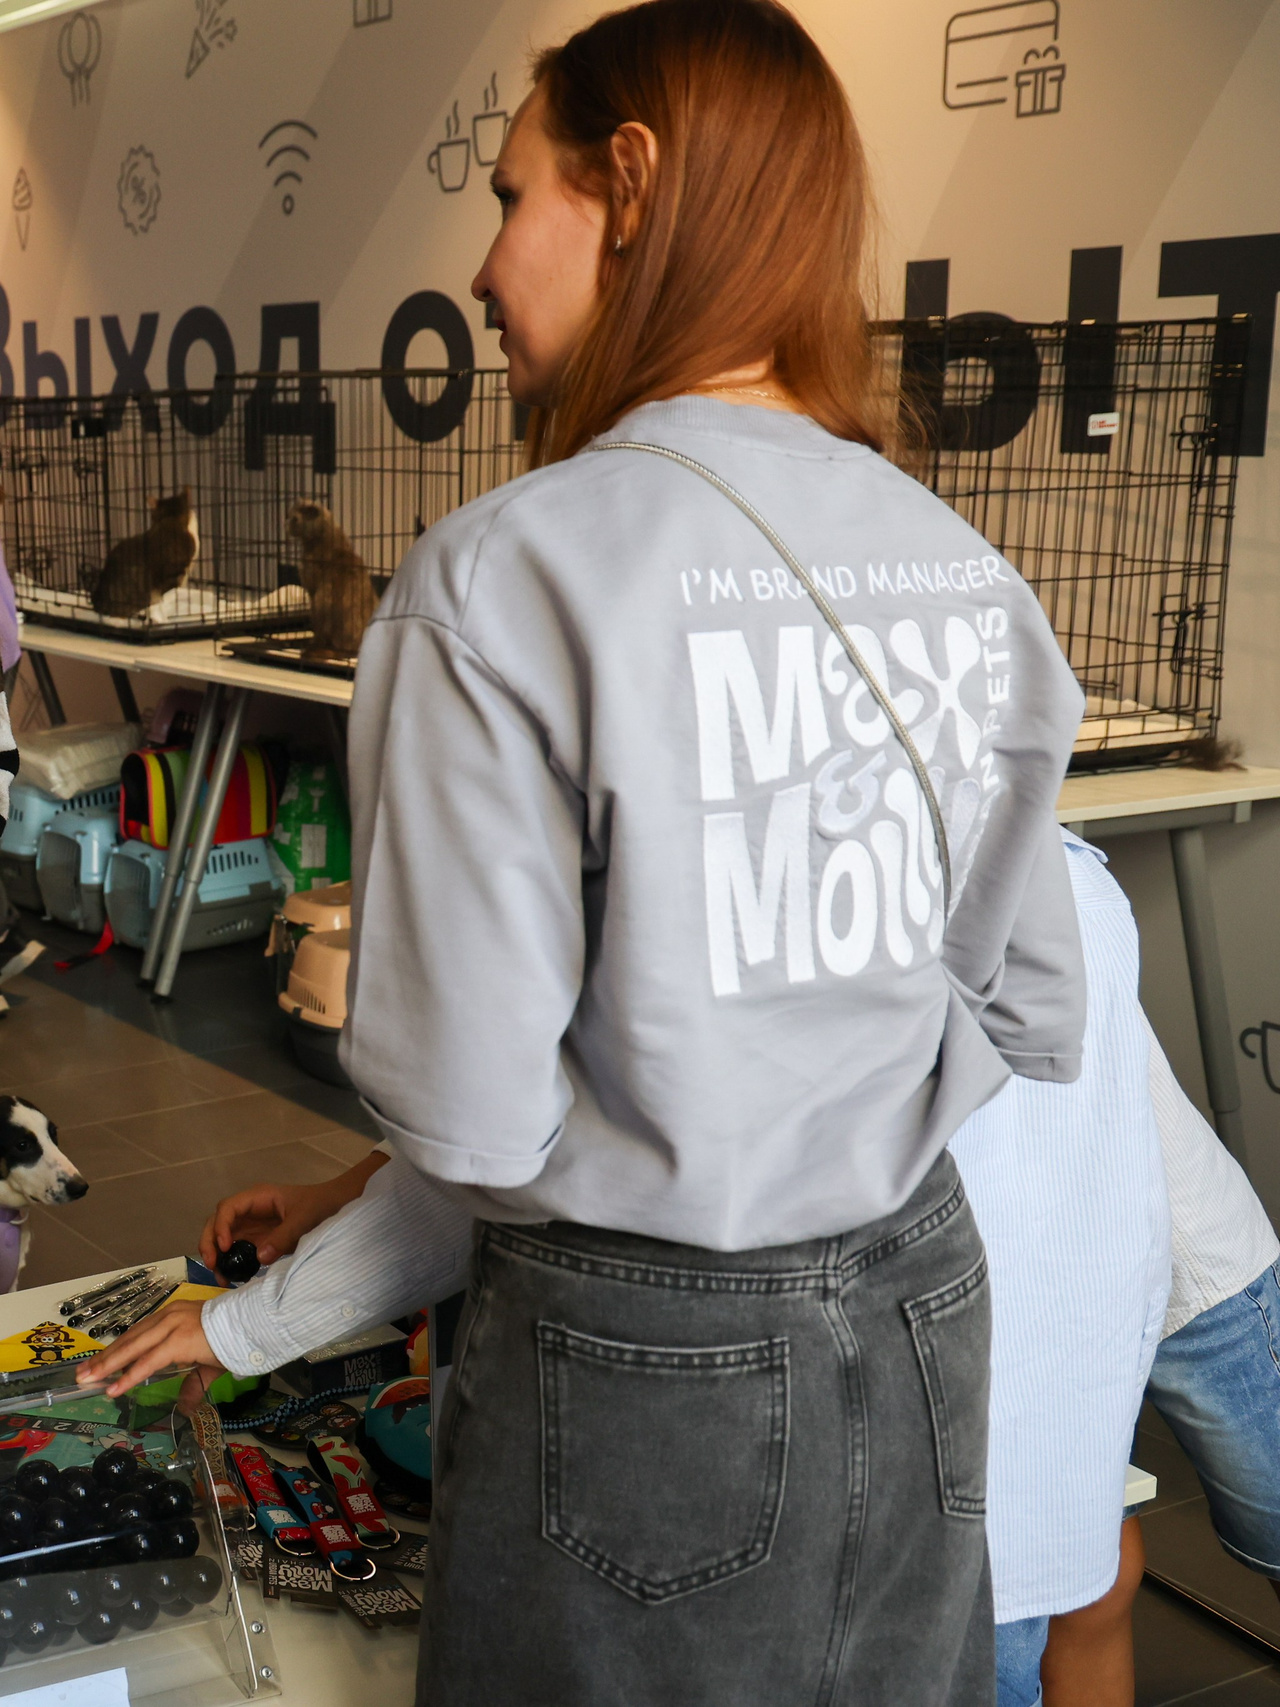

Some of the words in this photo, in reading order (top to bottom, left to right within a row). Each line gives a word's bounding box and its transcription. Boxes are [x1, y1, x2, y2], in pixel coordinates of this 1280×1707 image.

[680, 568, 744, 605] I'M
[867, 555, 1010, 597] MANAGER
[687, 616, 982, 801] Max
[344, 1353, 376, 1376] Max
[278, 1564, 332, 1581] Molly
[403, 1562, 425, 1570] URBA
[278, 1575, 333, 1593] Max
[354, 1588, 410, 1606] Molly
[362, 1599, 421, 1615] Max
